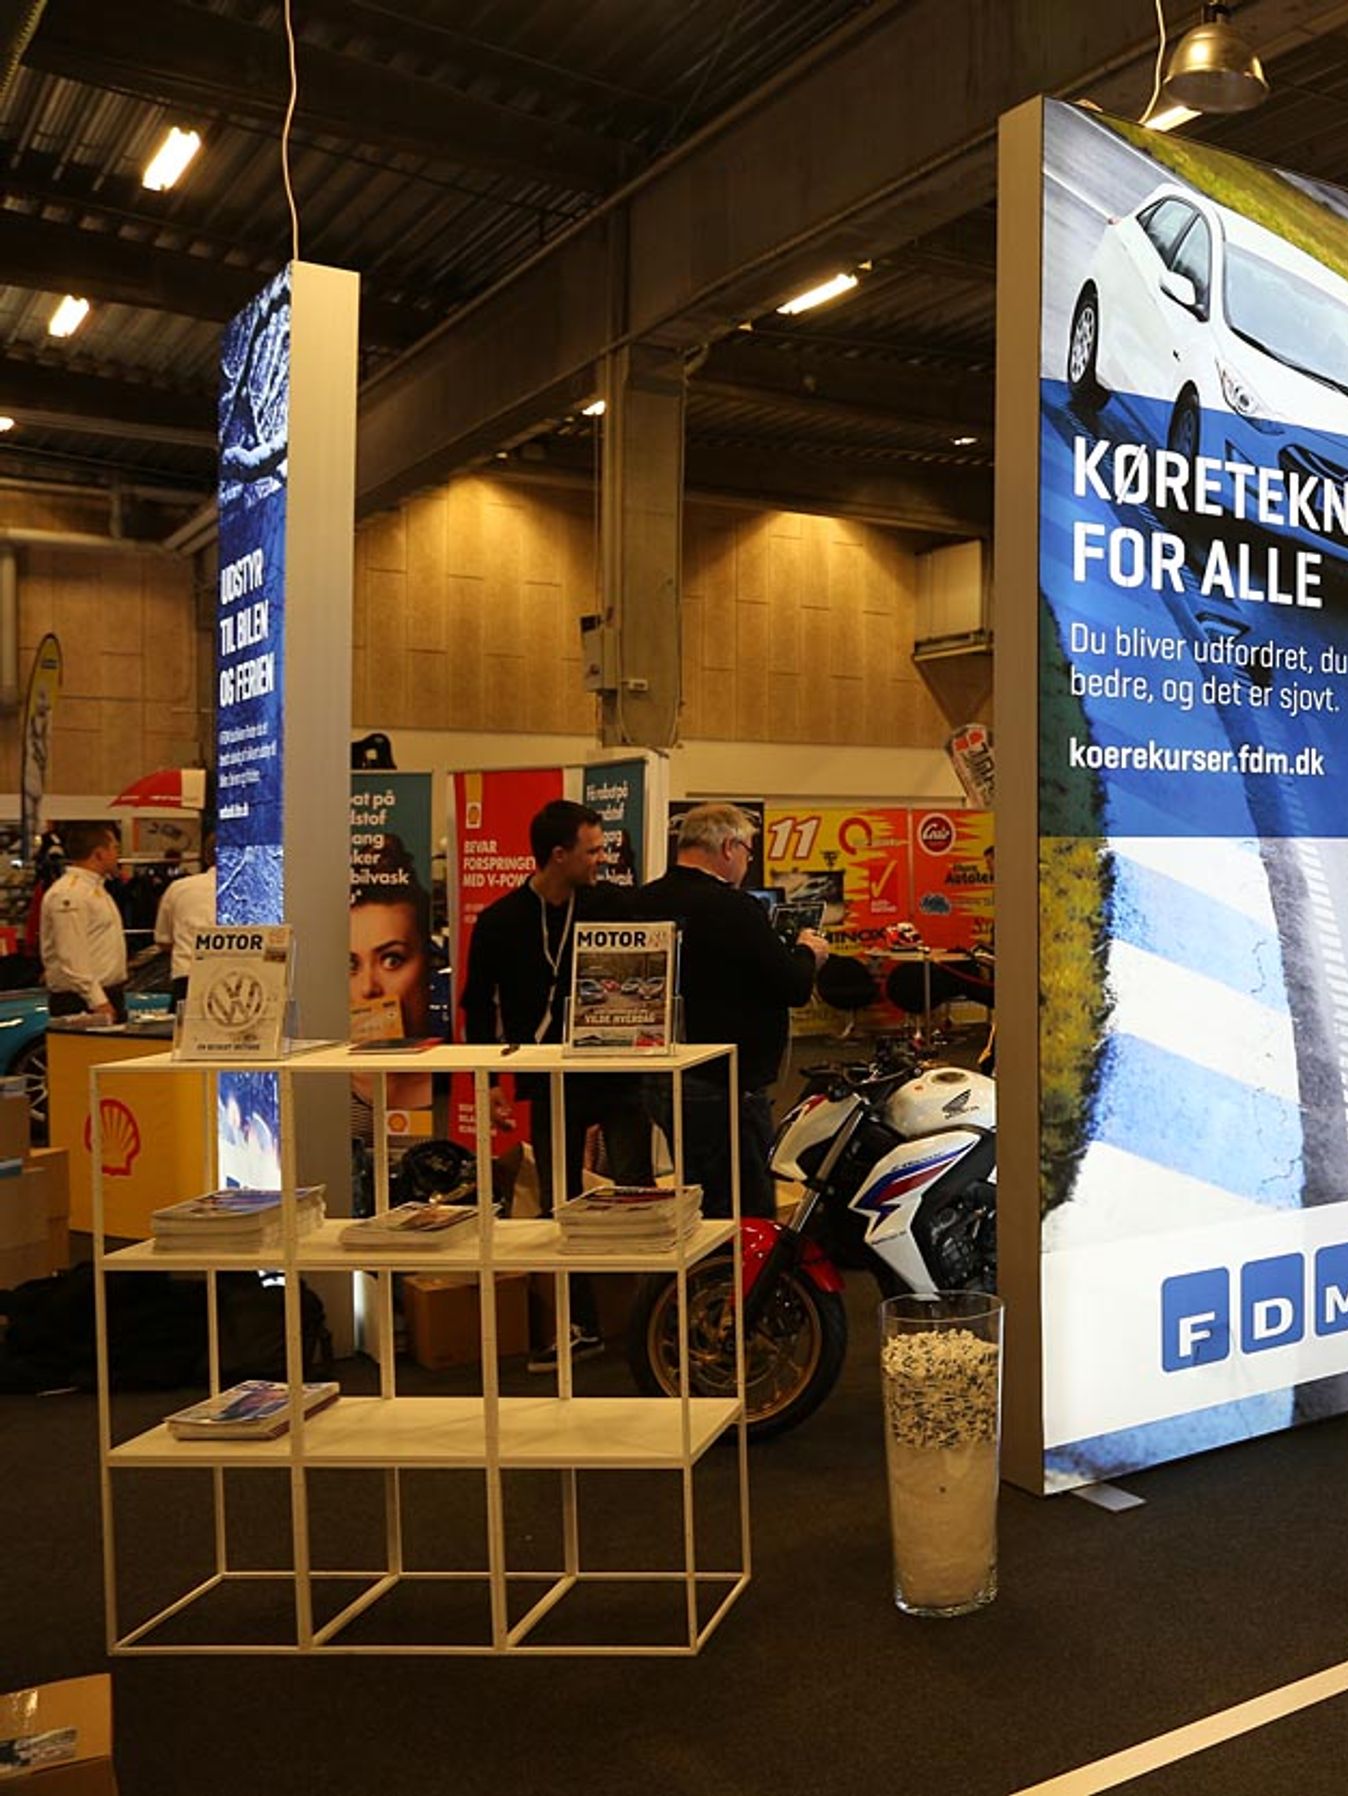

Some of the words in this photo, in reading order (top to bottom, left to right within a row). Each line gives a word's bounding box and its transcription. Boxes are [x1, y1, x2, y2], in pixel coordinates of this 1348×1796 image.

[1073, 521, 1186, 593] FOR
[1202, 539, 1323, 608] ALLE
[220, 615, 236, 656] TIL
[237, 599, 269, 649] BILEN
[1071, 623, 1106, 656] Du
[1116, 628, 1186, 661] bliver
[1194, 636, 1313, 675] udfordret,
[1320, 647, 1348, 674] du
[220, 667, 234, 708] OG
[235, 652, 275, 702] FERIEN
[1071, 667, 1153, 704] bedre,
[1162, 679, 1194, 708] og
[1202, 676, 1242, 707] det
[1249, 685, 1272, 707] er
[1280, 684, 1340, 716] sjovt.
[1069, 738, 1325, 776] koerekurser.fdm.dk
[372, 789, 395, 809] på
[768, 816, 821, 861] 11
[462, 873, 485, 887] MED
[196, 934, 263, 951] MOTOR
[577, 931, 646, 947] MOTOR
